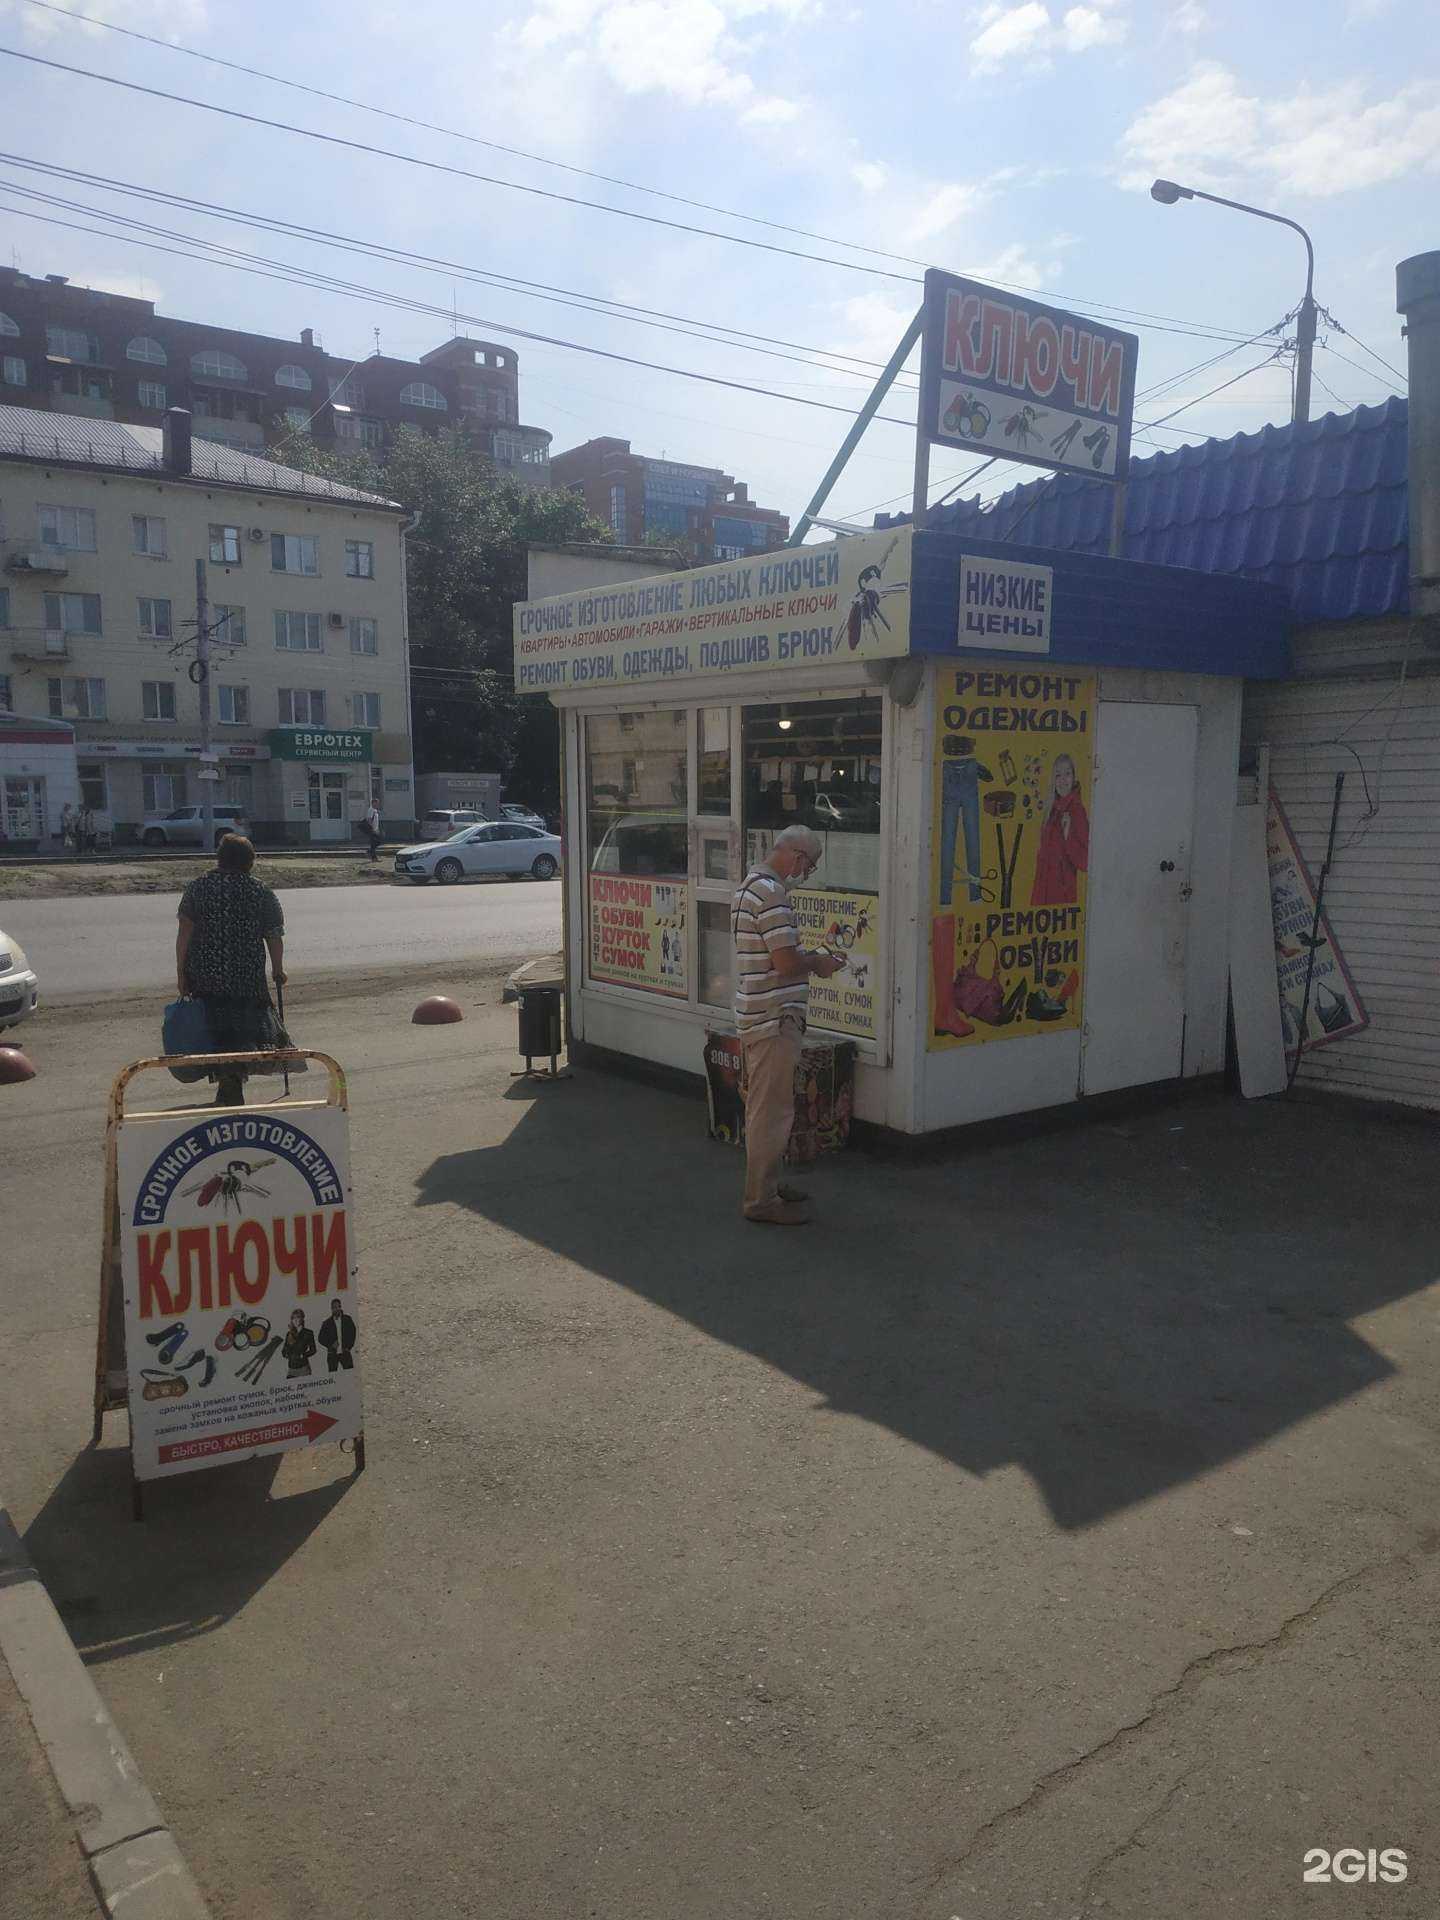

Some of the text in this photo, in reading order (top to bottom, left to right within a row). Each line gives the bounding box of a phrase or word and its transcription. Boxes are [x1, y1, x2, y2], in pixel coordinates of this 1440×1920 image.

[943, 288, 1123, 417] КЛЮЧИ
[519, 546, 840, 635] СРОЧНОЕ ИЗГОТОВЛЕНИЕ ЛЮБЫХ КЛЮЧЕЙ
[787, 593, 838, 616] КЛЮЧИ
[966, 570, 1045, 612] НИЗКИЕ
[966, 611, 1043, 637] ЦЕНЫ
[520, 626, 834, 685] РЕМОНТ ОБУВИ, ОДЕЖДЫ, ПОДШИВ БРЮК
[955, 671, 1082, 701] РЕМОНТ
[943, 705, 1087, 734] ОДЕЖДЫ
[294, 734, 362, 747] ЕВРОТЕХ
[295, 748, 338, 758] СЕРВИСНЫЙ
[592, 878, 652, 908] КЛЮЧИ
[791, 895, 857, 916] ЗГОТОВЛЕНИЕ
[601, 906, 644, 929] ОБУВИ
[986, 908, 1081, 938] РЕМОНТ
[601, 926, 650, 951] КУРТОК
[601, 946, 646, 971] СУМОК
[1000, 936, 1080, 984] ОБУВИ
[844, 991, 873, 1009] СУМОК
[140, 1120, 339, 1222] СРОЧНОЕ ИЗГОТОВЛЕНИЕ
[136, 1208, 349, 1321] КЛЮЧИ
[159, 1399, 201, 1415] срочный
[203, 1394, 236, 1409] ремонт
[171, 1423, 304, 1458] БЫСТРО, КАЧЕСТВЕННО!
